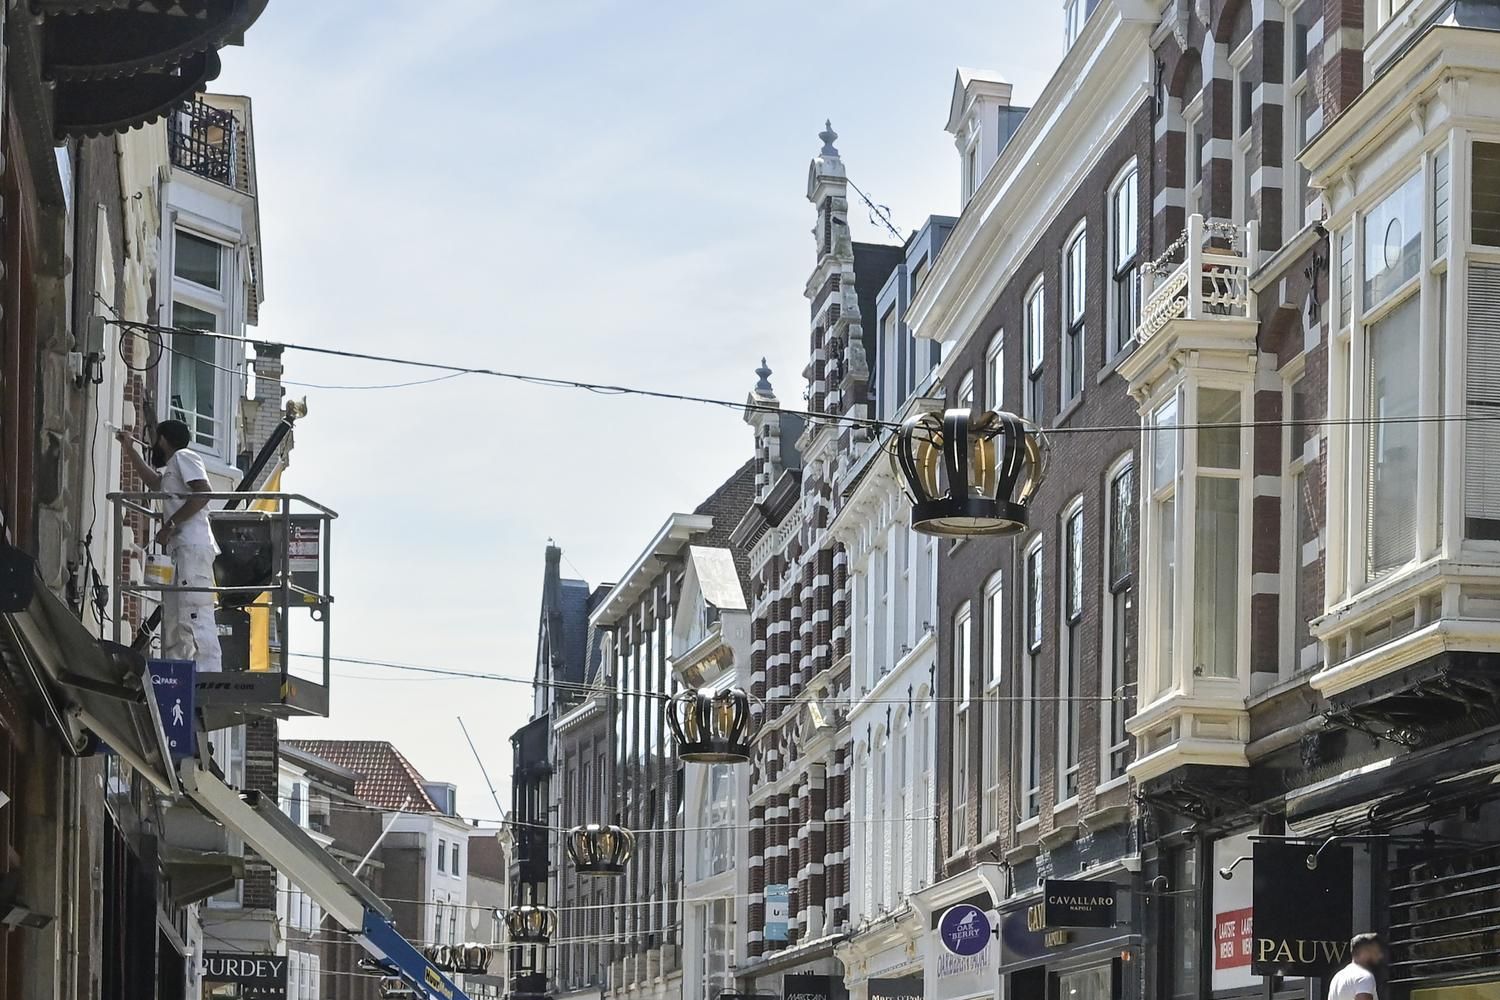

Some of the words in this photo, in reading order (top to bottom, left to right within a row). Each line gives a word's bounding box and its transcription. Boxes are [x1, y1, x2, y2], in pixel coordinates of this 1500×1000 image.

[1049, 895, 1114, 906] CAVALLARO
[956, 923, 974, 932] OAK
[952, 928, 980, 940] BERRY
[1257, 938, 1349, 964] PAUW
